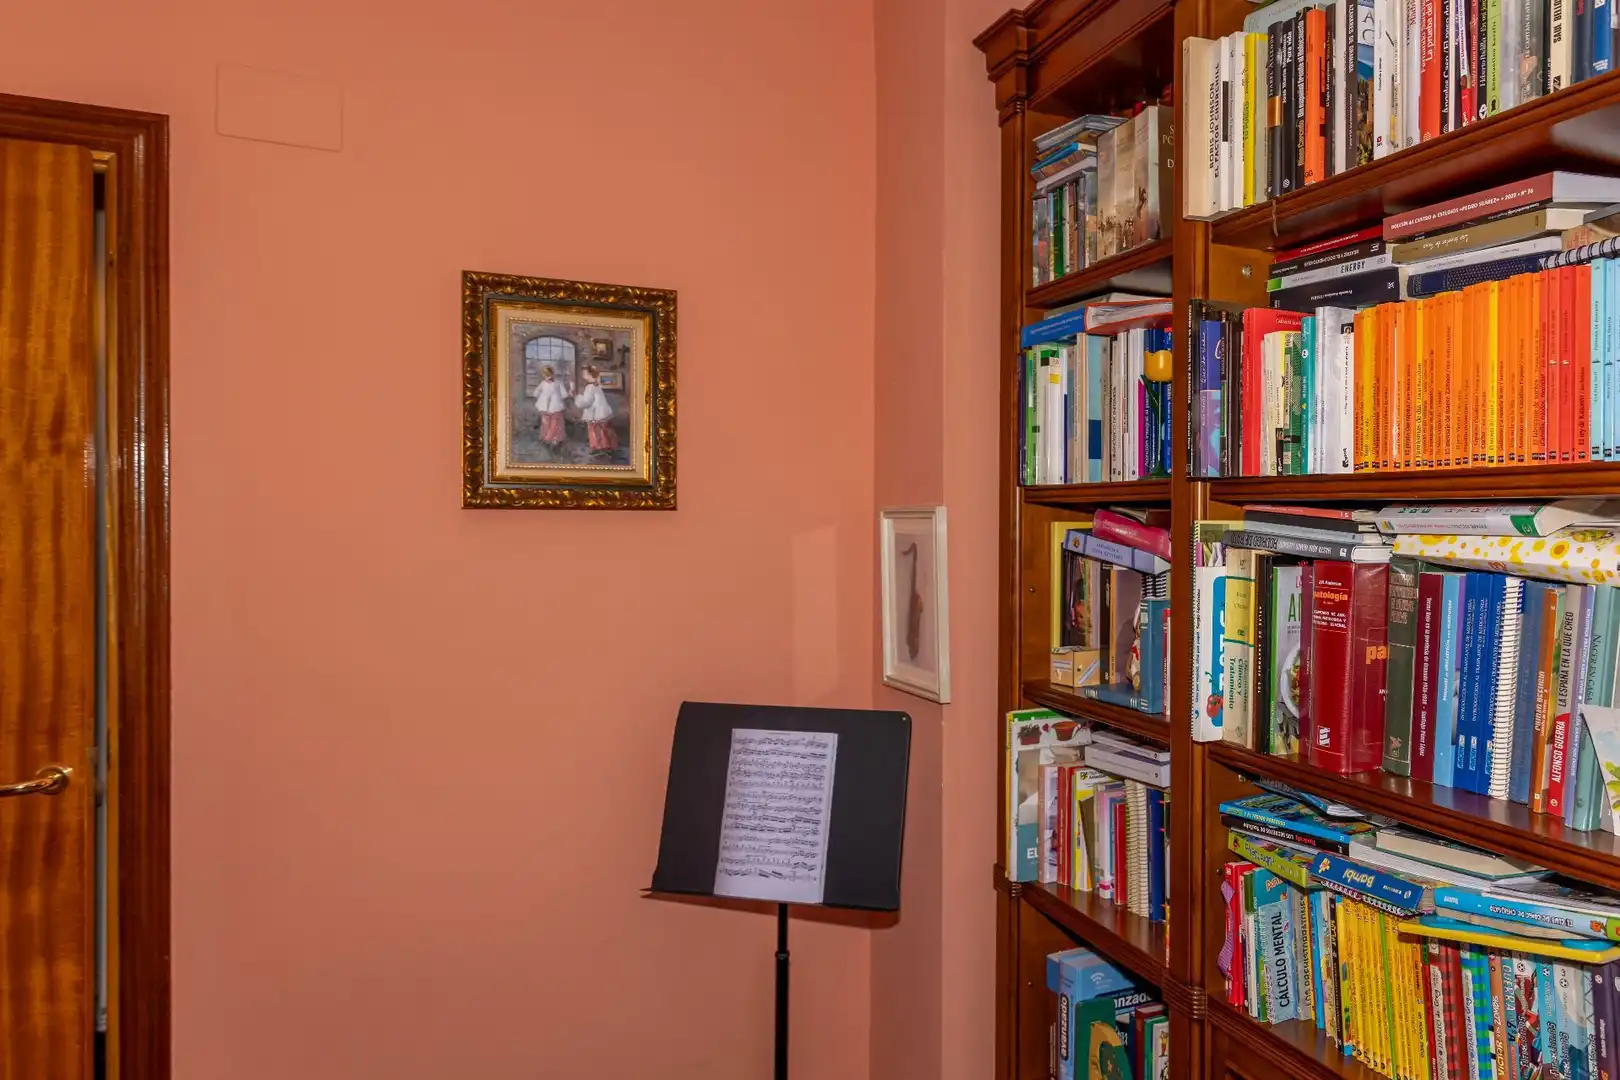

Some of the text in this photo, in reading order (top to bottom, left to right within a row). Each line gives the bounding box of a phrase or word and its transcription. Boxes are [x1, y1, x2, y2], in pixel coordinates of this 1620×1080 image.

[1348, 35, 1355, 45] DE
[1426, 17, 1434, 47] prueba
[1426, 48, 1433, 61] La
[1414, 215, 1432, 224] CENTRO
[1340, 260, 1365, 274] ENERGY
[1416, 415, 1422, 424] de
[1423, 634, 1431, 656] provincia
[1585, 634, 1602, 702] NACER EN CASA
[1460, 682, 1469, 721] INTRODUCCION
[1472, 682, 1481, 721] INTRODUCCION
[1487, 684, 1496, 725] INTRODUCCION
[1552, 611, 1575, 783] ALFONSO GUERRA LA ESPAÑA EN LA QUE CREO
[1343, 868, 1376, 888] Bambi
[1517, 910, 1573, 927] EL CLUB DE DE
[1270, 911, 1290, 1008] CÁLCULO MENTAL
[1433, 989, 1441, 1007] Greg
[1502, 964, 1515, 1012] GUERRA
[1464, 996, 1472, 1014] Greg
[1435, 1019, 1444, 1049] DIARIO
[1467, 1021, 1475, 1053] DIARIO
[1492, 995, 1505, 1076] VICTOR ZOMBIS
